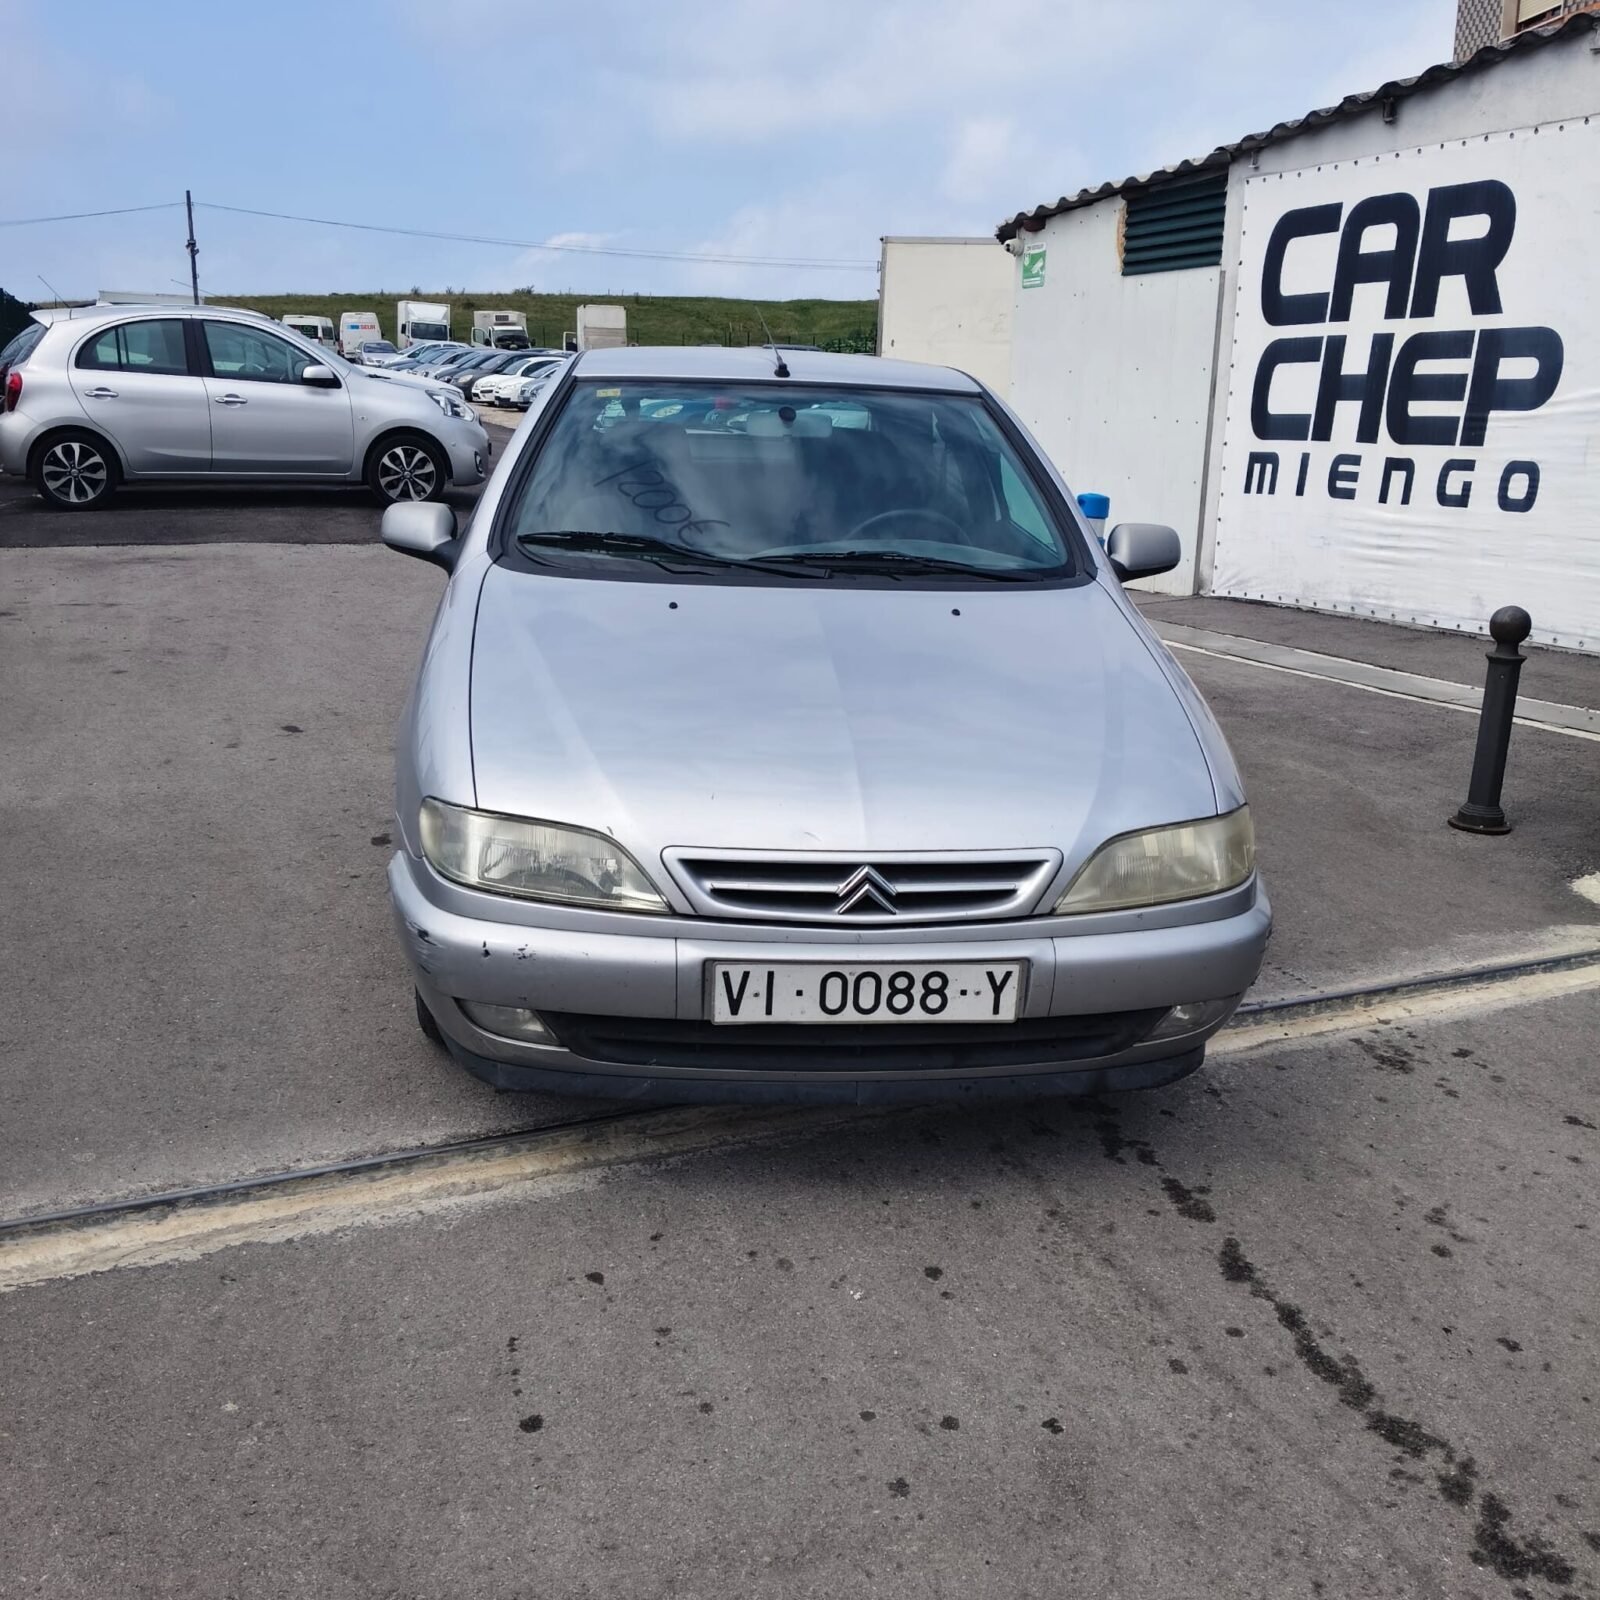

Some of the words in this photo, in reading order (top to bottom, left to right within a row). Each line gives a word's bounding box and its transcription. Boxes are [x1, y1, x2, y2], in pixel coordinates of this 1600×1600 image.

[1261, 179, 1517, 327] CAR
[1251, 326, 1564, 447] CHEP
[1244, 451, 1541, 513] MIENGO
